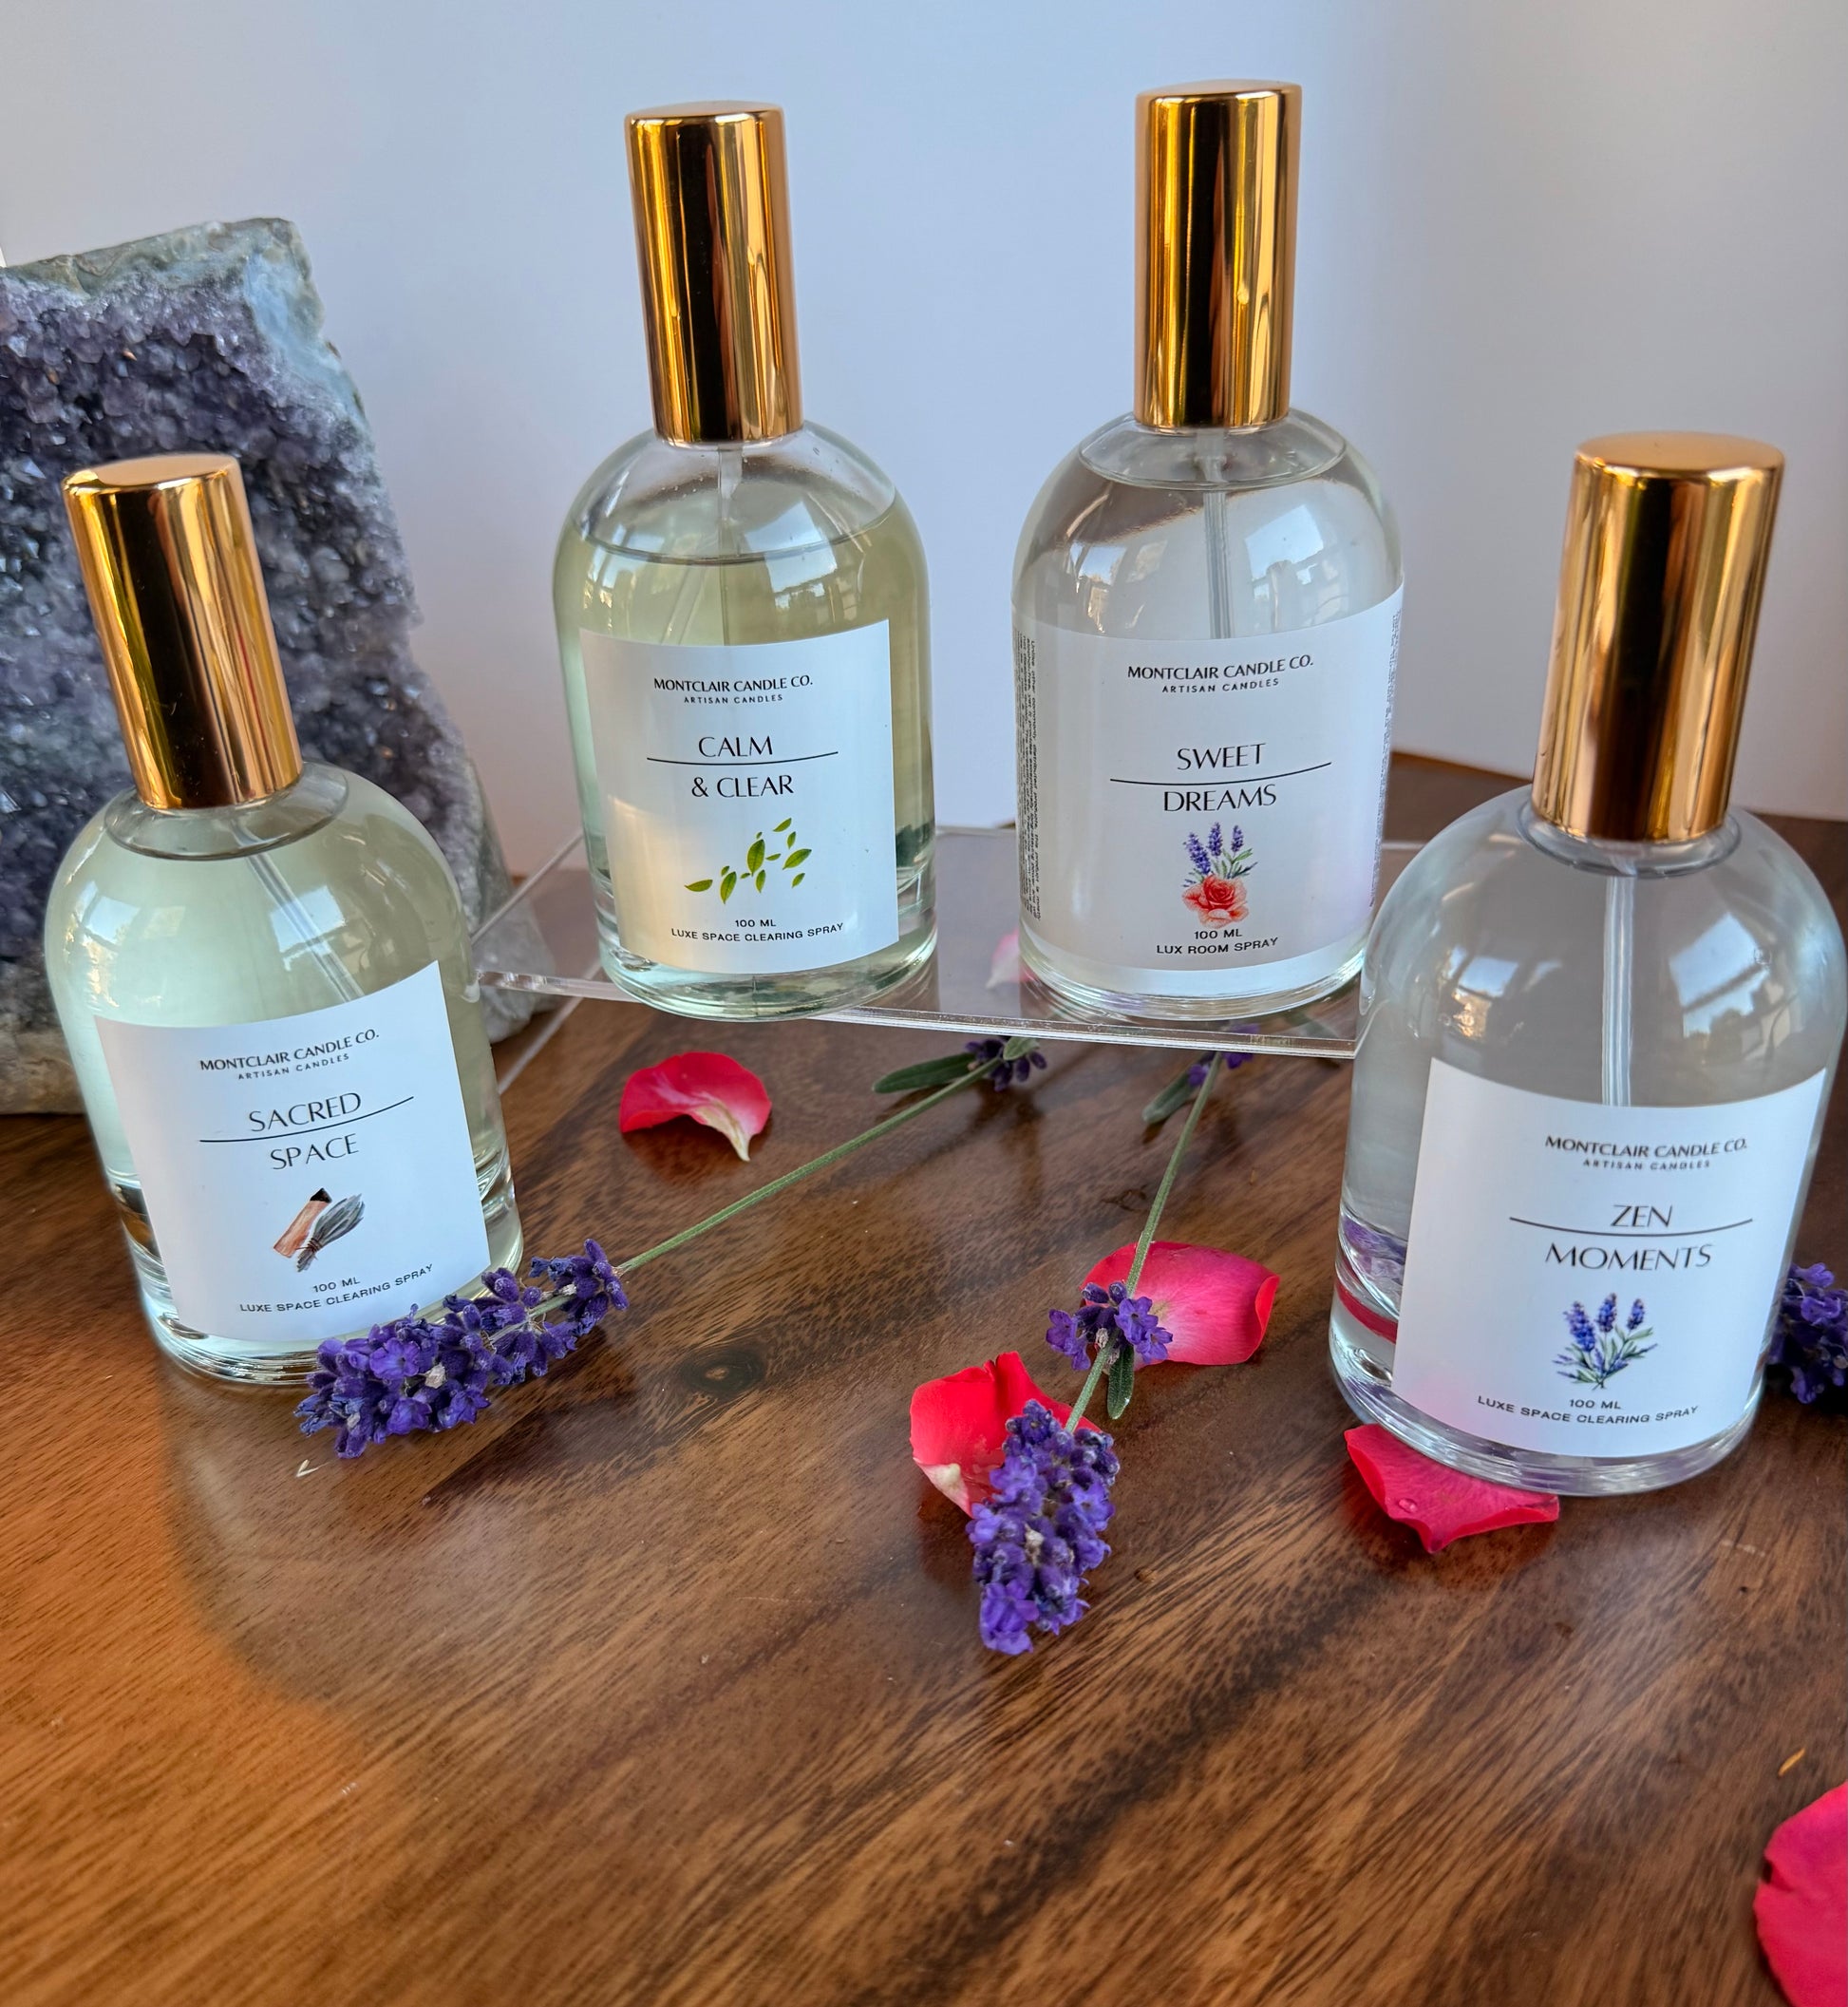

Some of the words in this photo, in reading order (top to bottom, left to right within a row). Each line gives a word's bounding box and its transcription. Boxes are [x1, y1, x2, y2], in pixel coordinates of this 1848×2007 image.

[1127, 666, 1219, 680] MONTCLAIR
[1223, 659, 1285, 678] CANDLE
[1289, 654, 1314, 670] CO.
[653, 677, 731, 692] MONTCLAIR
[733, 677, 787, 692] CANDLE
[790, 674, 813, 688] CO.
[1161, 684, 1216, 693] ARTISAN
[1221, 677, 1279, 692] CANDLES
[684, 696, 728, 705] ARTISAN
[733, 693, 783, 705] CANDLES
[698, 735, 773, 758] CALM
[1178, 744, 1265, 769] SWEET
[691, 776, 709, 798] &
[716, 774, 794, 798] CLEAR
[1163, 785, 1276, 811] DREAMS
[670, 928, 698, 939] LUXE
[702, 932, 741, 942] SPACE
[745, 930, 803, 942] CLEARING
[807, 922, 843, 937] SPRAY
[734, 918, 756, 928] 100
[760, 918, 777, 927] ML
[1194, 930, 1218, 940] 100
[1223, 928, 1242, 938] ML
[1156, 944, 1183, 955] LUX
[1187, 943, 1229, 955] ROOM
[1234, 935, 1278, 952] SPRAY
[199, 1051, 291, 1072] MONTCLAIR
[293, 1036, 353, 1060] CANDLE
[355, 1029, 380, 1044] CO.
[237, 1066, 290, 1080] ARTISAN
[294, 1053, 350, 1072] CANDLES
[249, 1093, 363, 1131] SACRED
[271, 1134, 359, 1169] SPACE
[1545, 1135, 1650, 1158] MONTCLAIR
[1653, 1142, 1721, 1159] CANDLE
[1724, 1138, 1747, 1153] CO.
[1582, 1158, 1643, 1170] ARTISAN
[1650, 1160, 1710, 1171] CANDLES
[1610, 1204, 1672, 1228] ZEN
[1546, 1243, 1710, 1270] MOMENTS
[239, 1303, 273, 1313] LUXE
[275, 1299, 322, 1312] SPACE
[326, 1281, 390, 1305] CLEARING
[394, 1263, 433, 1286] SPRAY
[312, 1281, 337, 1293] 100
[341, 1277, 361, 1288] ML
[1478, 1394, 1515, 1413] LUXE
[1519, 1404, 1573, 1423] SPACE
[1575, 1414, 1650, 1425] CLEARING
[1654, 1406, 1698, 1422] SPRAY
[1570, 1398, 1595, 1409] 100
[1600, 1400, 1621, 1410] ML
